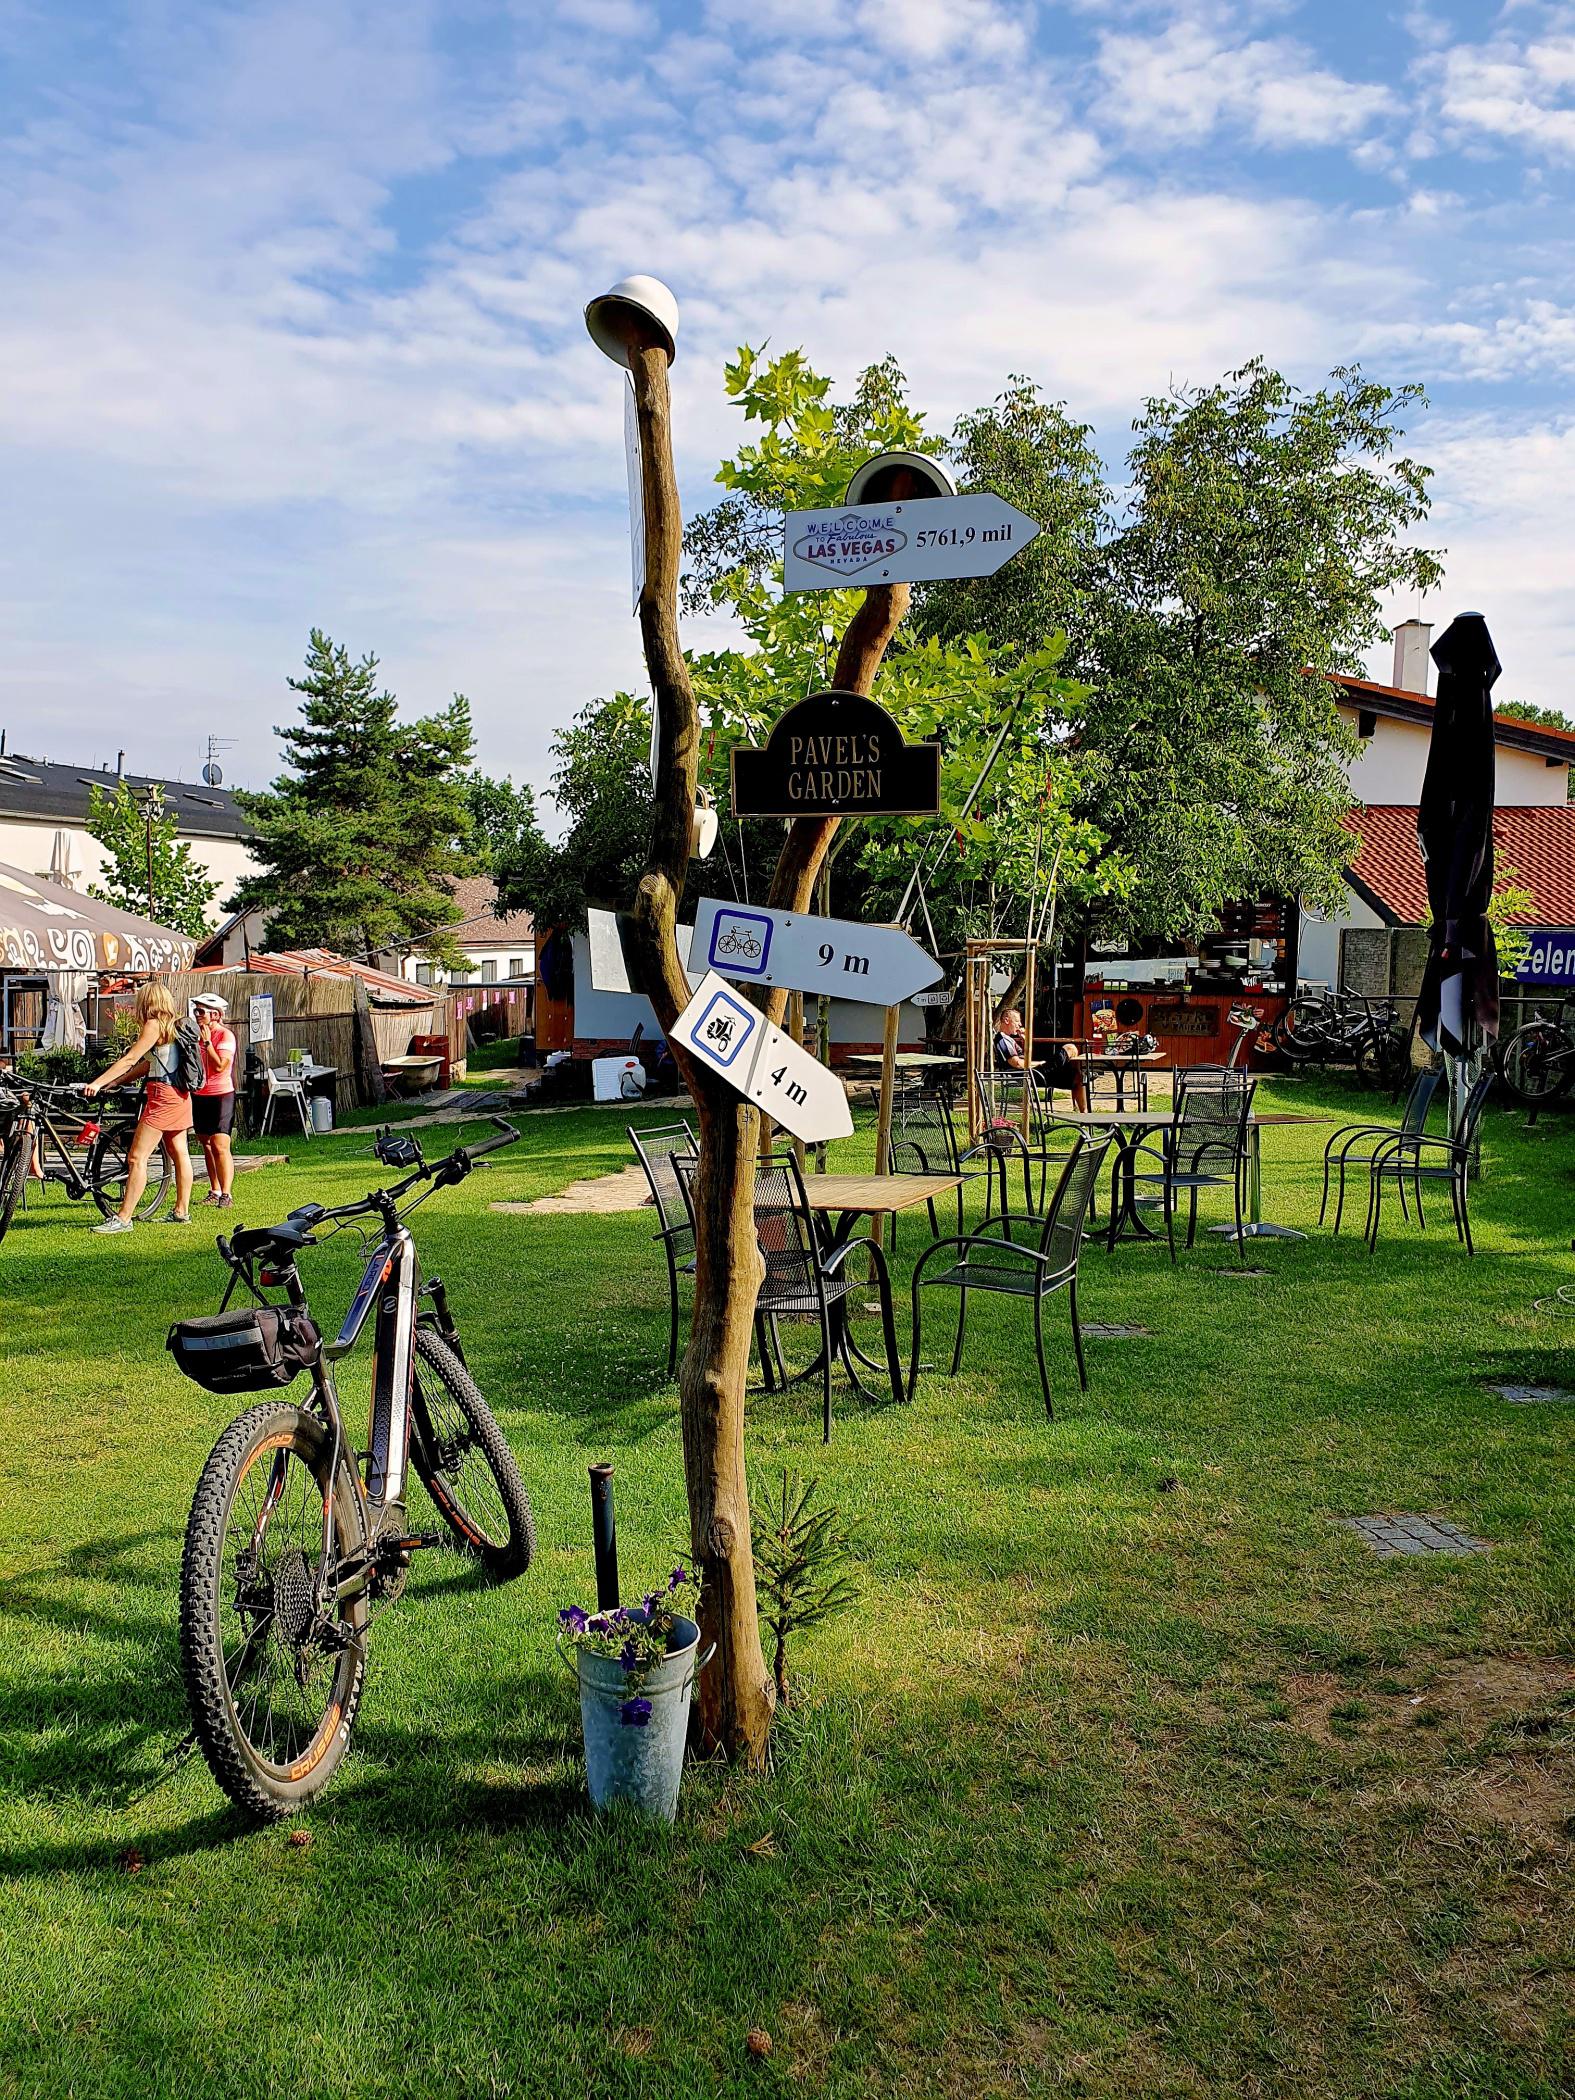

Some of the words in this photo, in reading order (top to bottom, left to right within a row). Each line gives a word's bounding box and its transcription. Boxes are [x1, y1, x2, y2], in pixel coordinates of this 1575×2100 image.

[808, 517, 894, 533] WELCOME
[827, 532, 877, 544] Fabulous
[916, 526, 976, 548] 5761,9
[981, 524, 1012, 543] mil
[808, 544, 836, 559] LAS
[841, 539, 895, 556] VEGAS
[830, 556, 868, 564] NEVADA
[790, 734, 880, 765] PAVEL'S
[788, 769, 882, 800] GARDEN
[816, 943, 835, 967] 9
[842, 954, 870, 976] m
[770, 1066, 788, 1087] 4
[785, 1080, 809, 1107] m
[340, 1660, 363, 1741] MAXXIS
[290, 1703, 341, 1780] CRUSSIS
